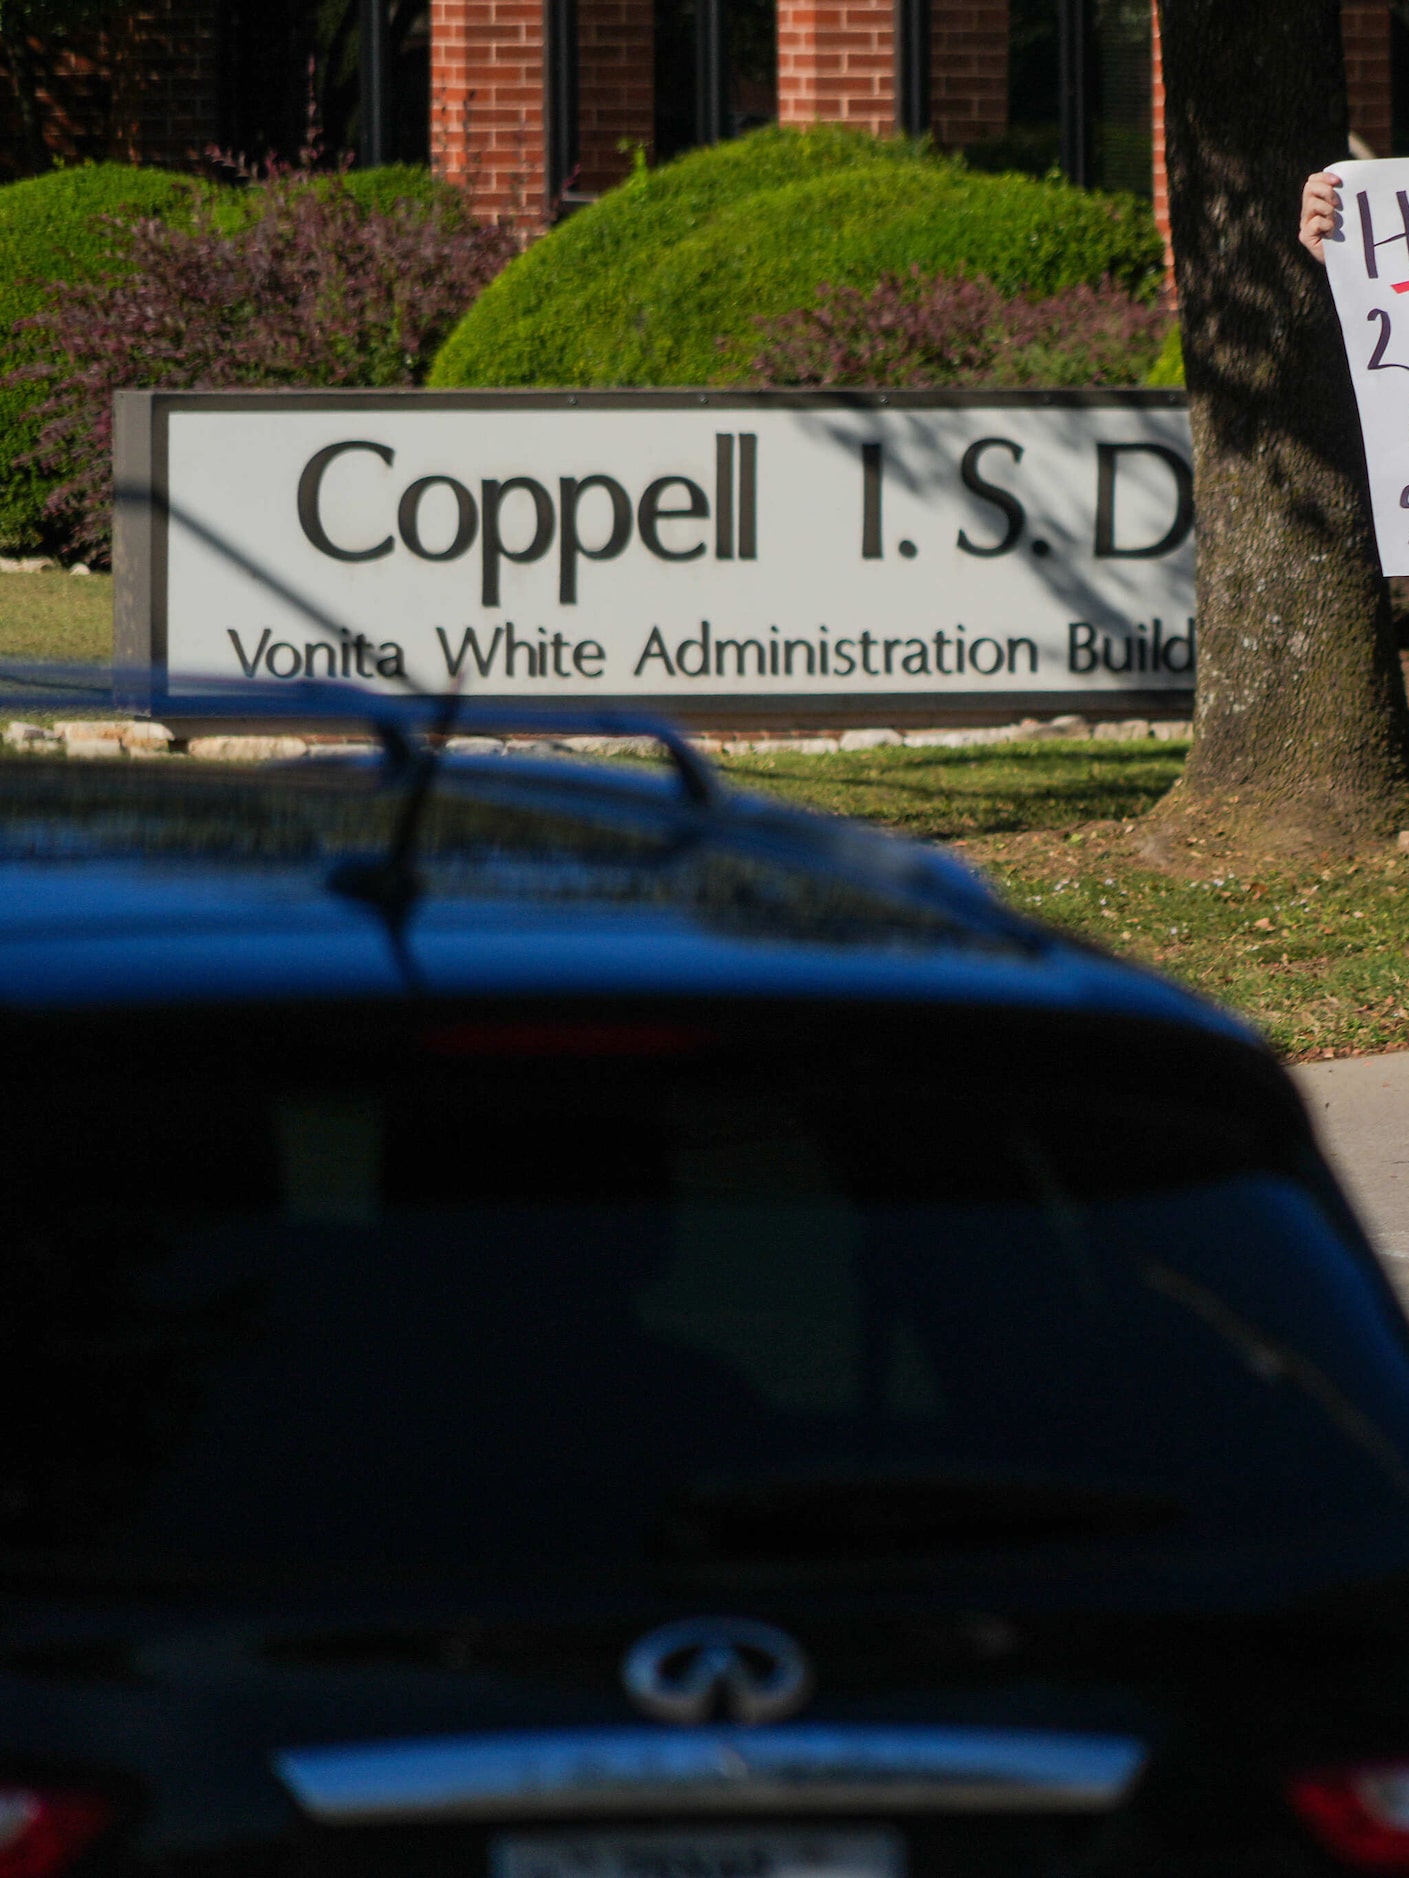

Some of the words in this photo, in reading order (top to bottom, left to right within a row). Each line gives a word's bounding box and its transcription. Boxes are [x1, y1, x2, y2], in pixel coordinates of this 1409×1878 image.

[297, 432, 757, 607] Coppell
[226, 626, 403, 679] Vonita
[436, 621, 606, 678] White
[634, 619, 1038, 677] Administration
